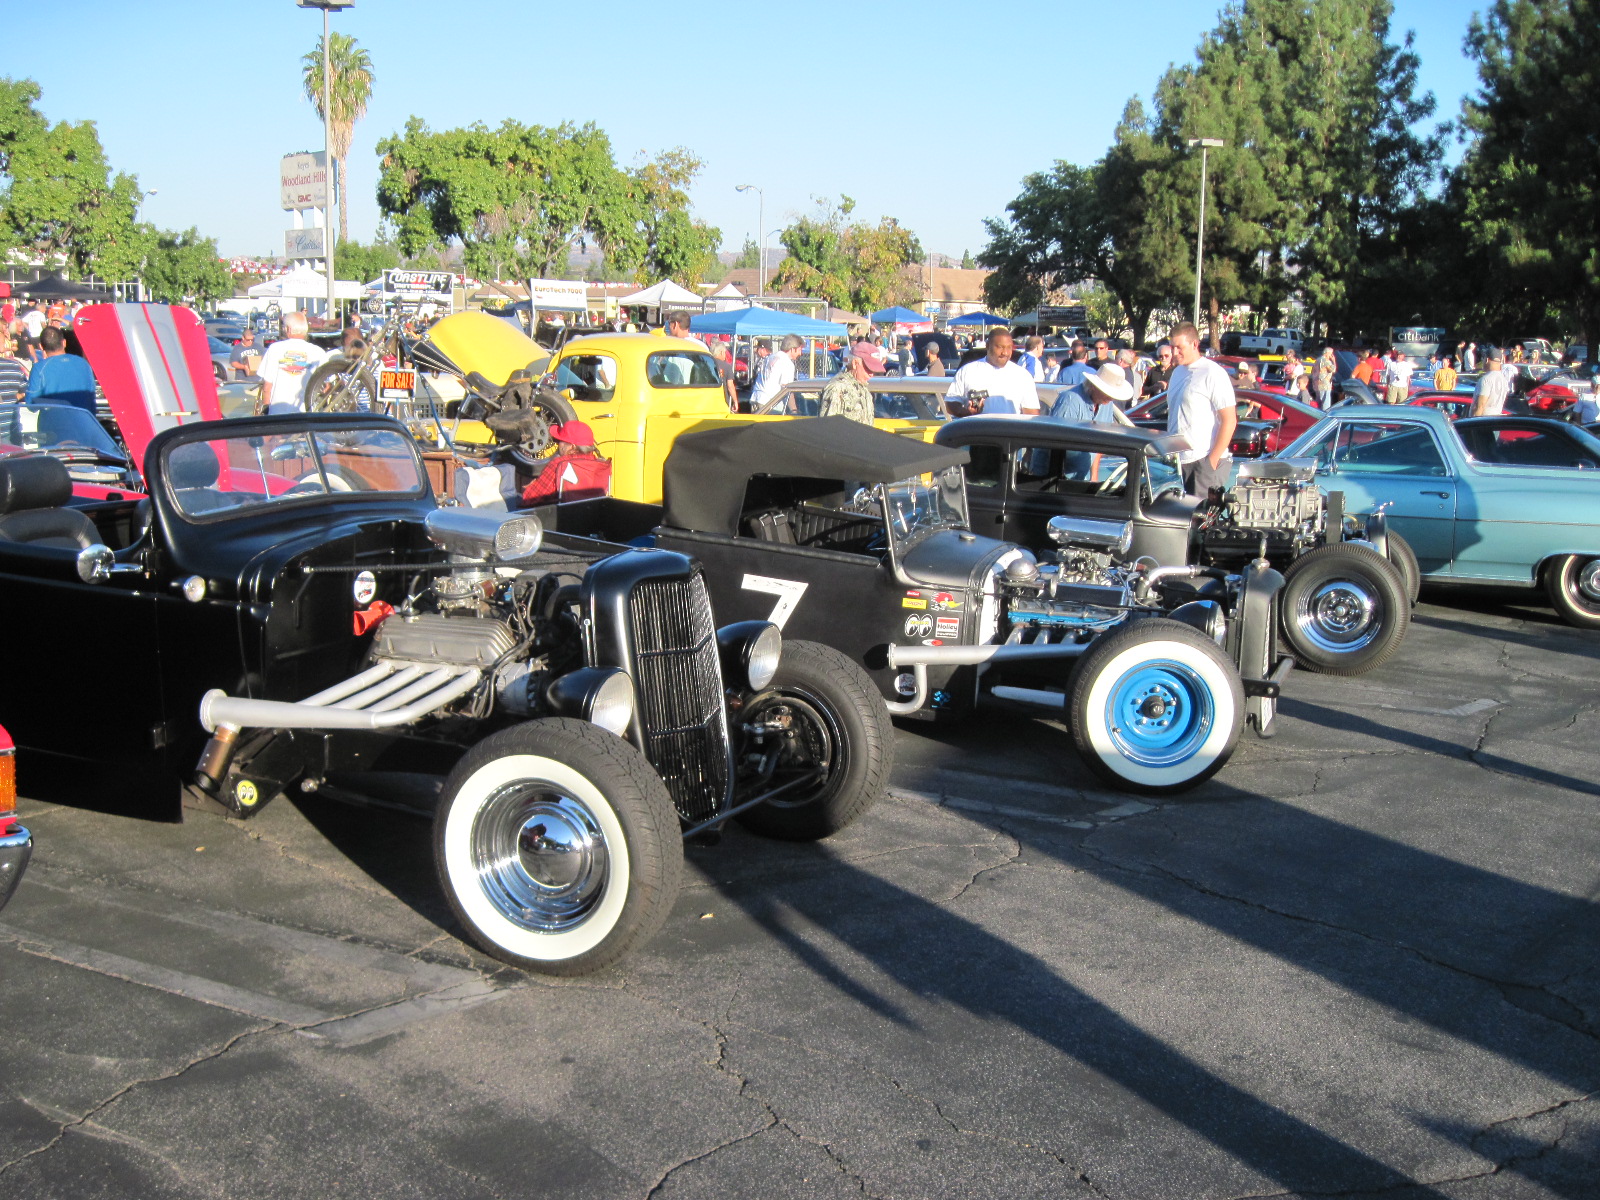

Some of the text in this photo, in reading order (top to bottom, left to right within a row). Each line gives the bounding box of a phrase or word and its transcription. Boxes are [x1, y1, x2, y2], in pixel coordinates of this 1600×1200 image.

[281, 173, 311, 187] Woodland
[297, 194, 311, 202] GMC
[534, 286, 566, 294] EuroTech
[1398, 331, 1439, 341] citibank
[380, 371, 415, 389] FOR SALE
[741, 574, 809, 632] 7
